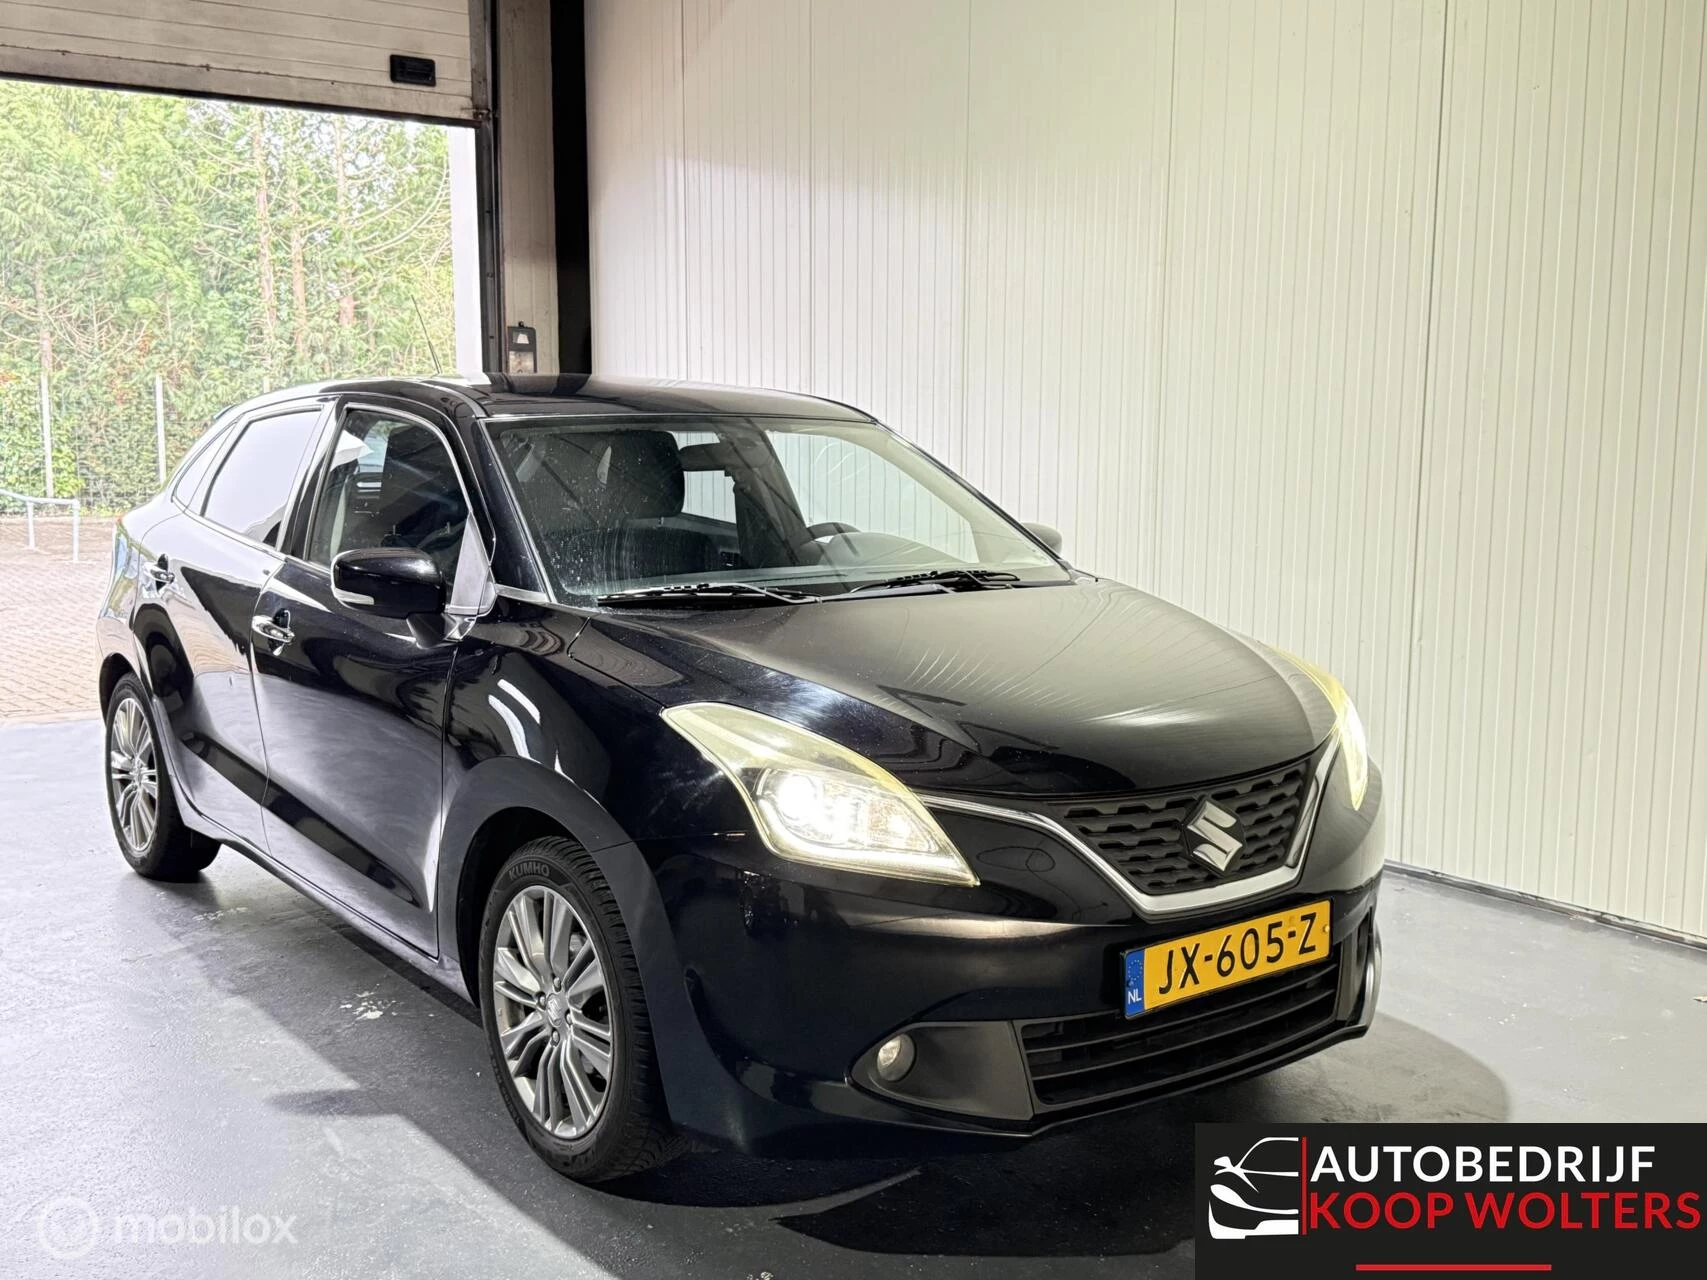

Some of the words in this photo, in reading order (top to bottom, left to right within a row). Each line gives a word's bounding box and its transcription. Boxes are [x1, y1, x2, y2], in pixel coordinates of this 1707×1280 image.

[508, 862, 550, 880] KUMHO
[1158, 911, 1318, 995] JX-605-Z
[1127, 988, 1143, 1005] NL
